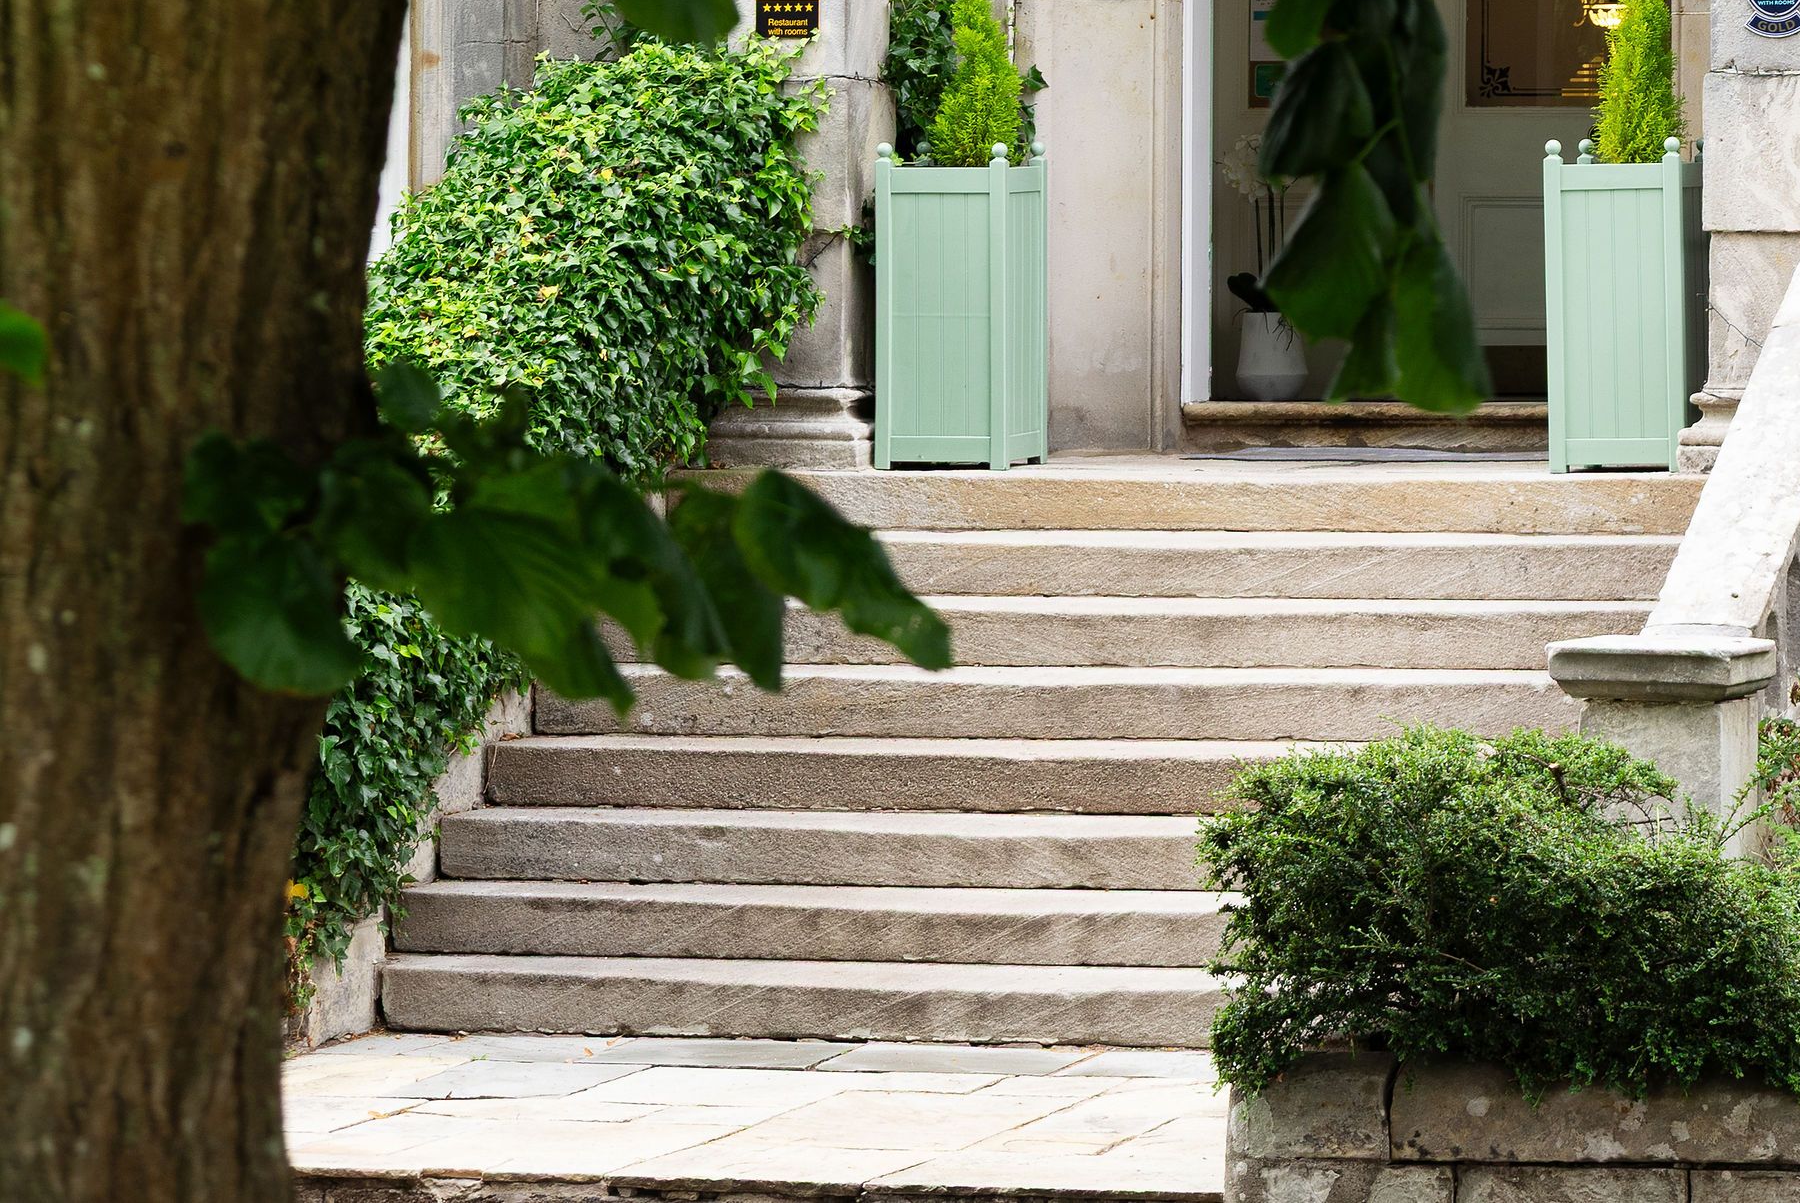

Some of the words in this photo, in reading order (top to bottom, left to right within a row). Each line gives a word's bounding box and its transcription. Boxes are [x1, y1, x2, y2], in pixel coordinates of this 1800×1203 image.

[1758, 20, 1795, 32] GOLD
[768, 28, 783, 36] with
[784, 28, 808, 36] rooms
